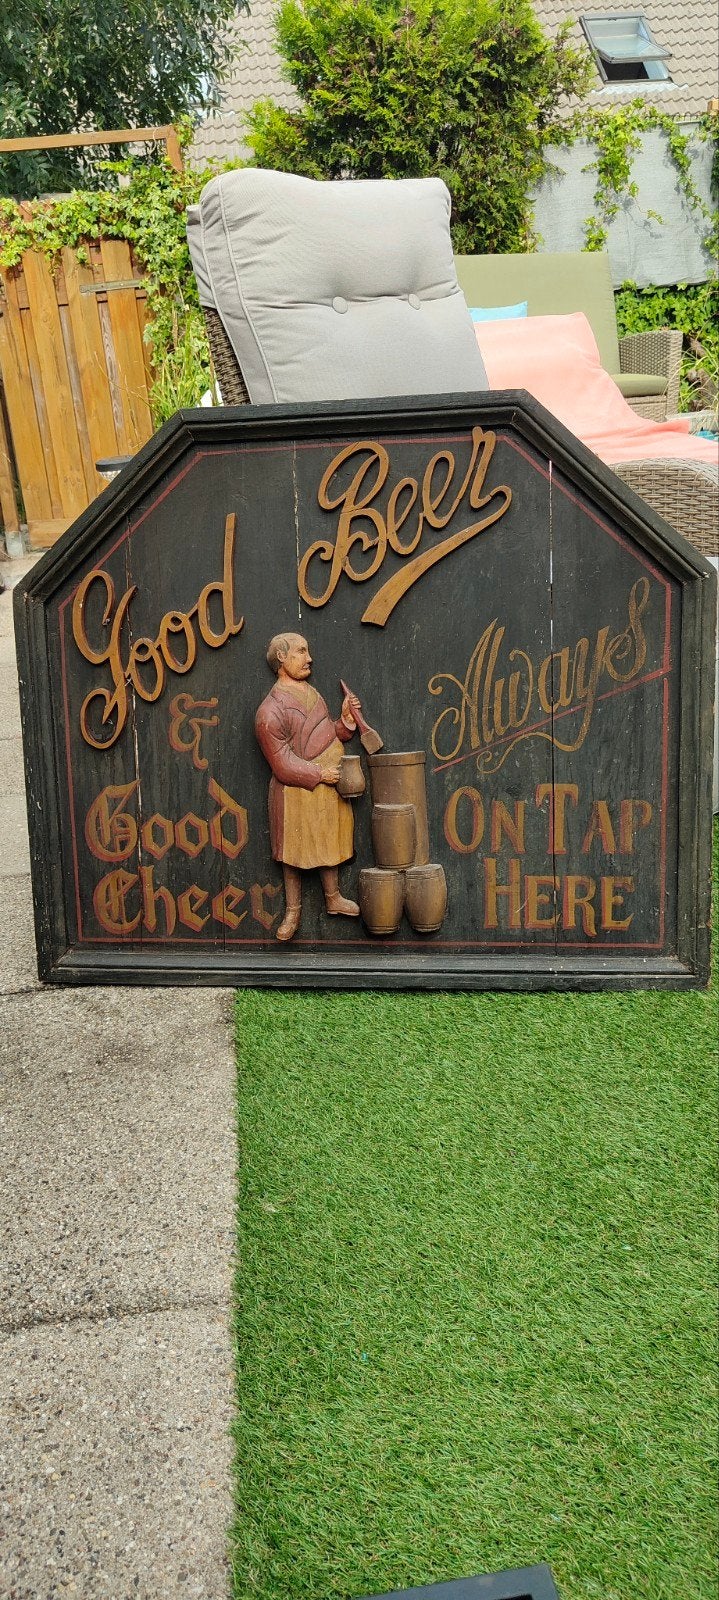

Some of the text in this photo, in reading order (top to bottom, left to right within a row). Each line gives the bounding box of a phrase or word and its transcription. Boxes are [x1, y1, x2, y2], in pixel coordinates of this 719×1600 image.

[72, 425, 511, 749] Good Beer
[428, 577, 650, 774] Always
[168, 692, 219, 769] &
[84, 778, 249, 864] Good
[93, 865, 283, 935] Cheer
